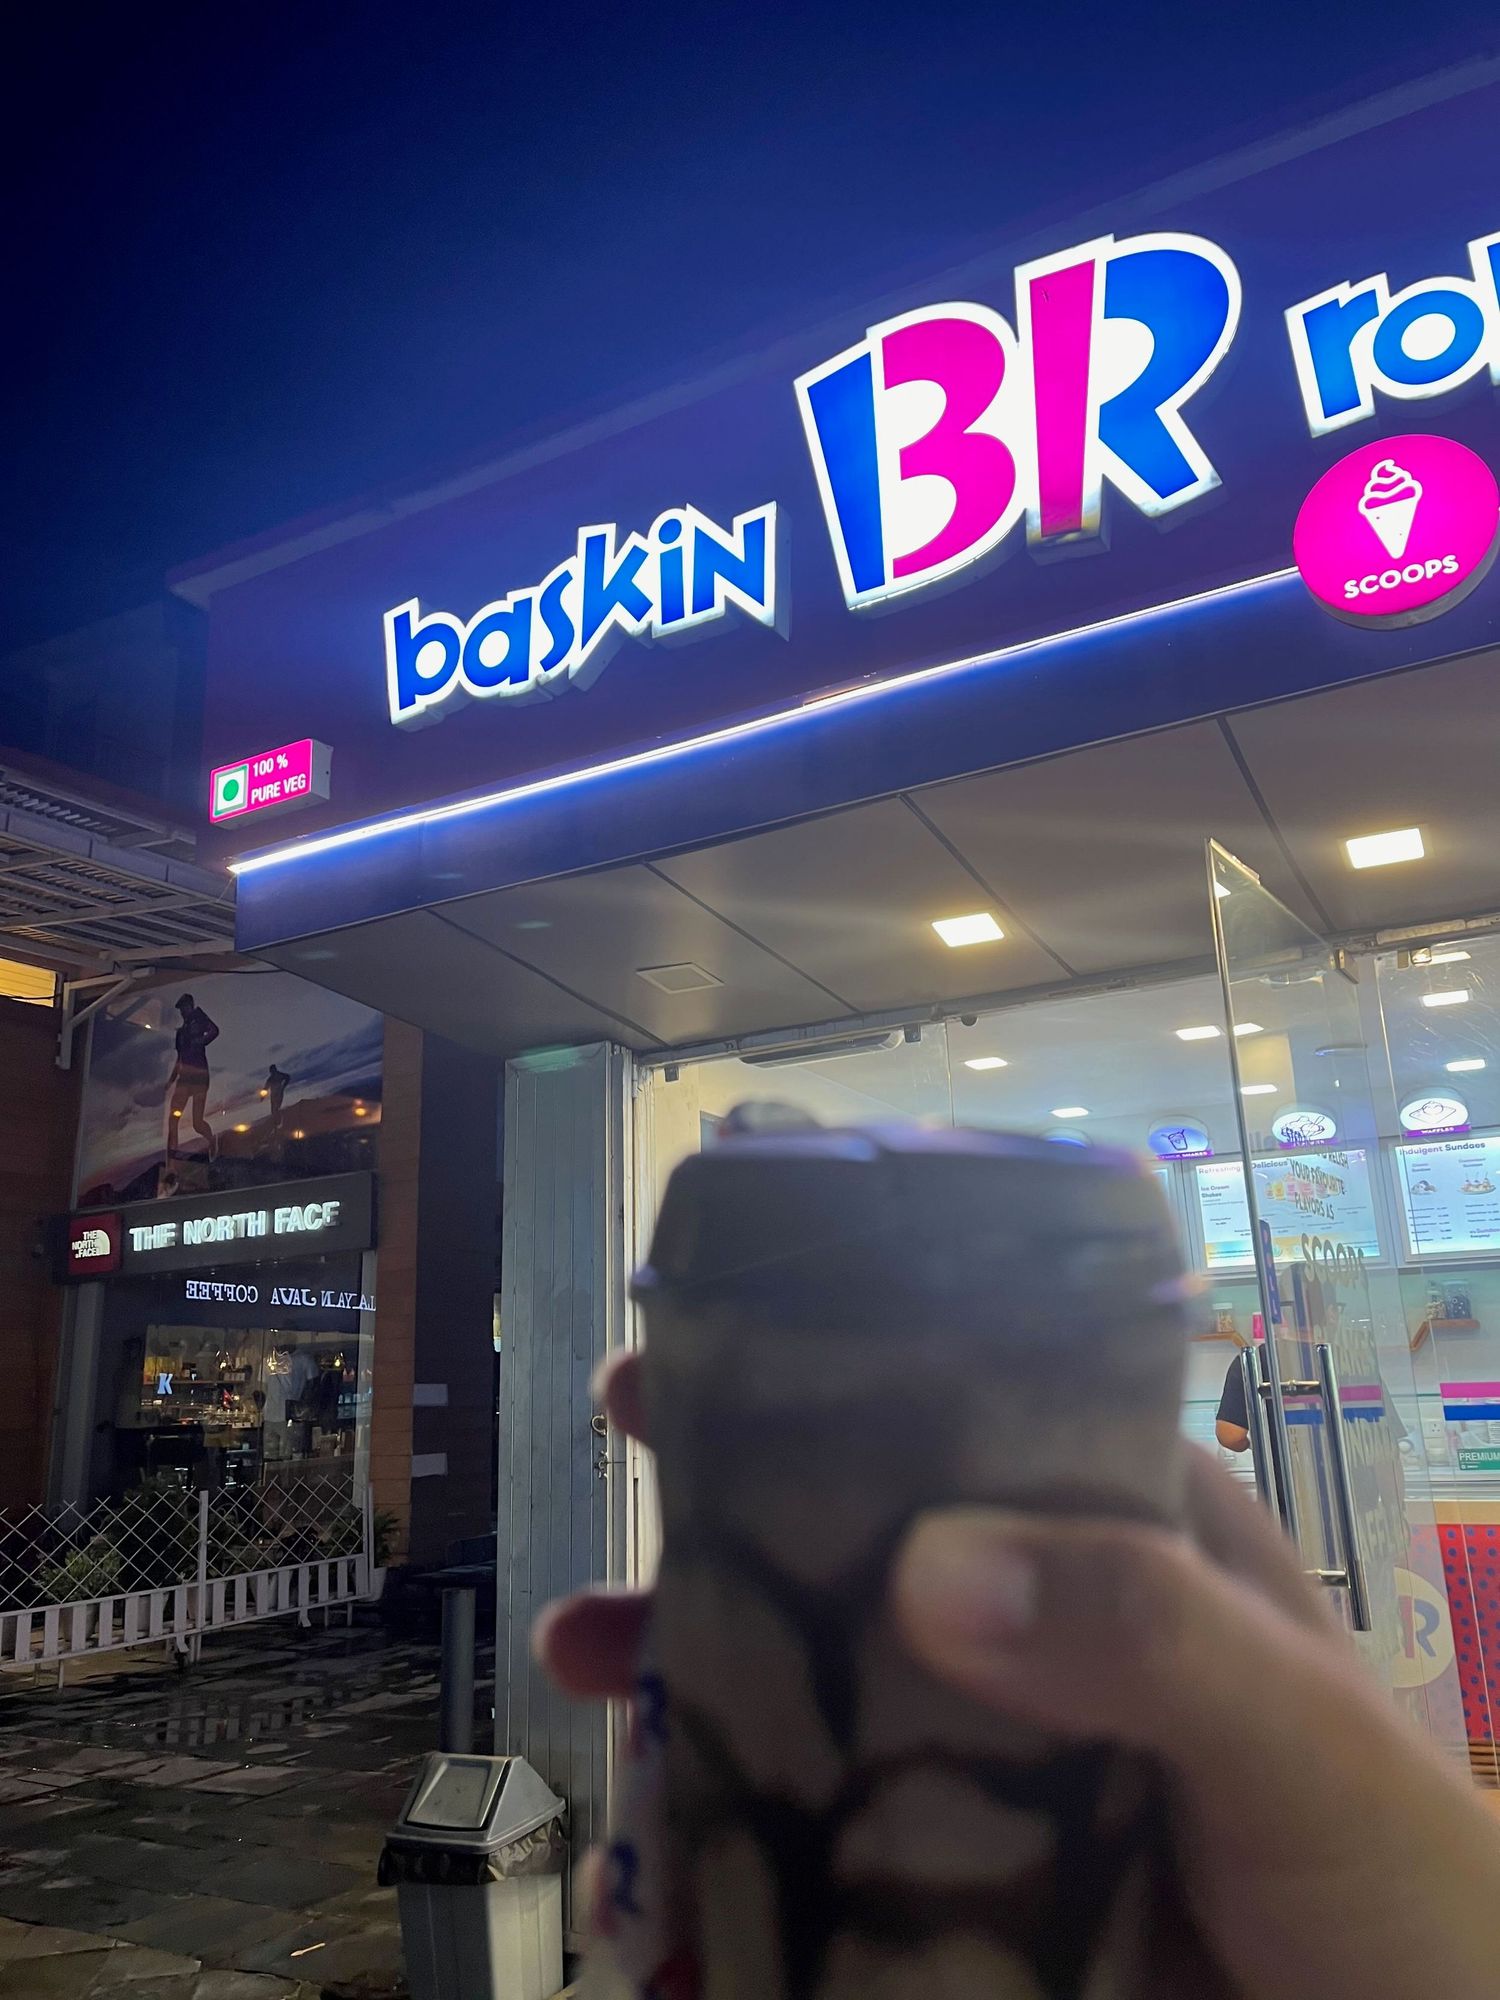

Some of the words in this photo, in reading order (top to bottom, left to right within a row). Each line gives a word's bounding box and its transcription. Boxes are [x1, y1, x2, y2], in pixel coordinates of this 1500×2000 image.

[794, 232, 1242, 611] BR
[1344, 555, 1459, 599] SCOOPS
[253, 758, 274, 777] 100
[276, 752, 288, 769] %
[251, 781, 281, 805] PURE
[283, 773, 306, 794] VEG
[1445, 1142, 1485, 1152] Sundaes
[1199, 1166, 1241, 1175] Refreshing
[1252, 1160, 1288, 1169] Delicious
[129, 1223, 176, 1251] THE
[183, 1211, 266, 1245] NORTH
[274, 1201, 341, 1234] FACE
[83, 1231, 97, 1241] THE
[79, 1248, 98, 1257] FACE
